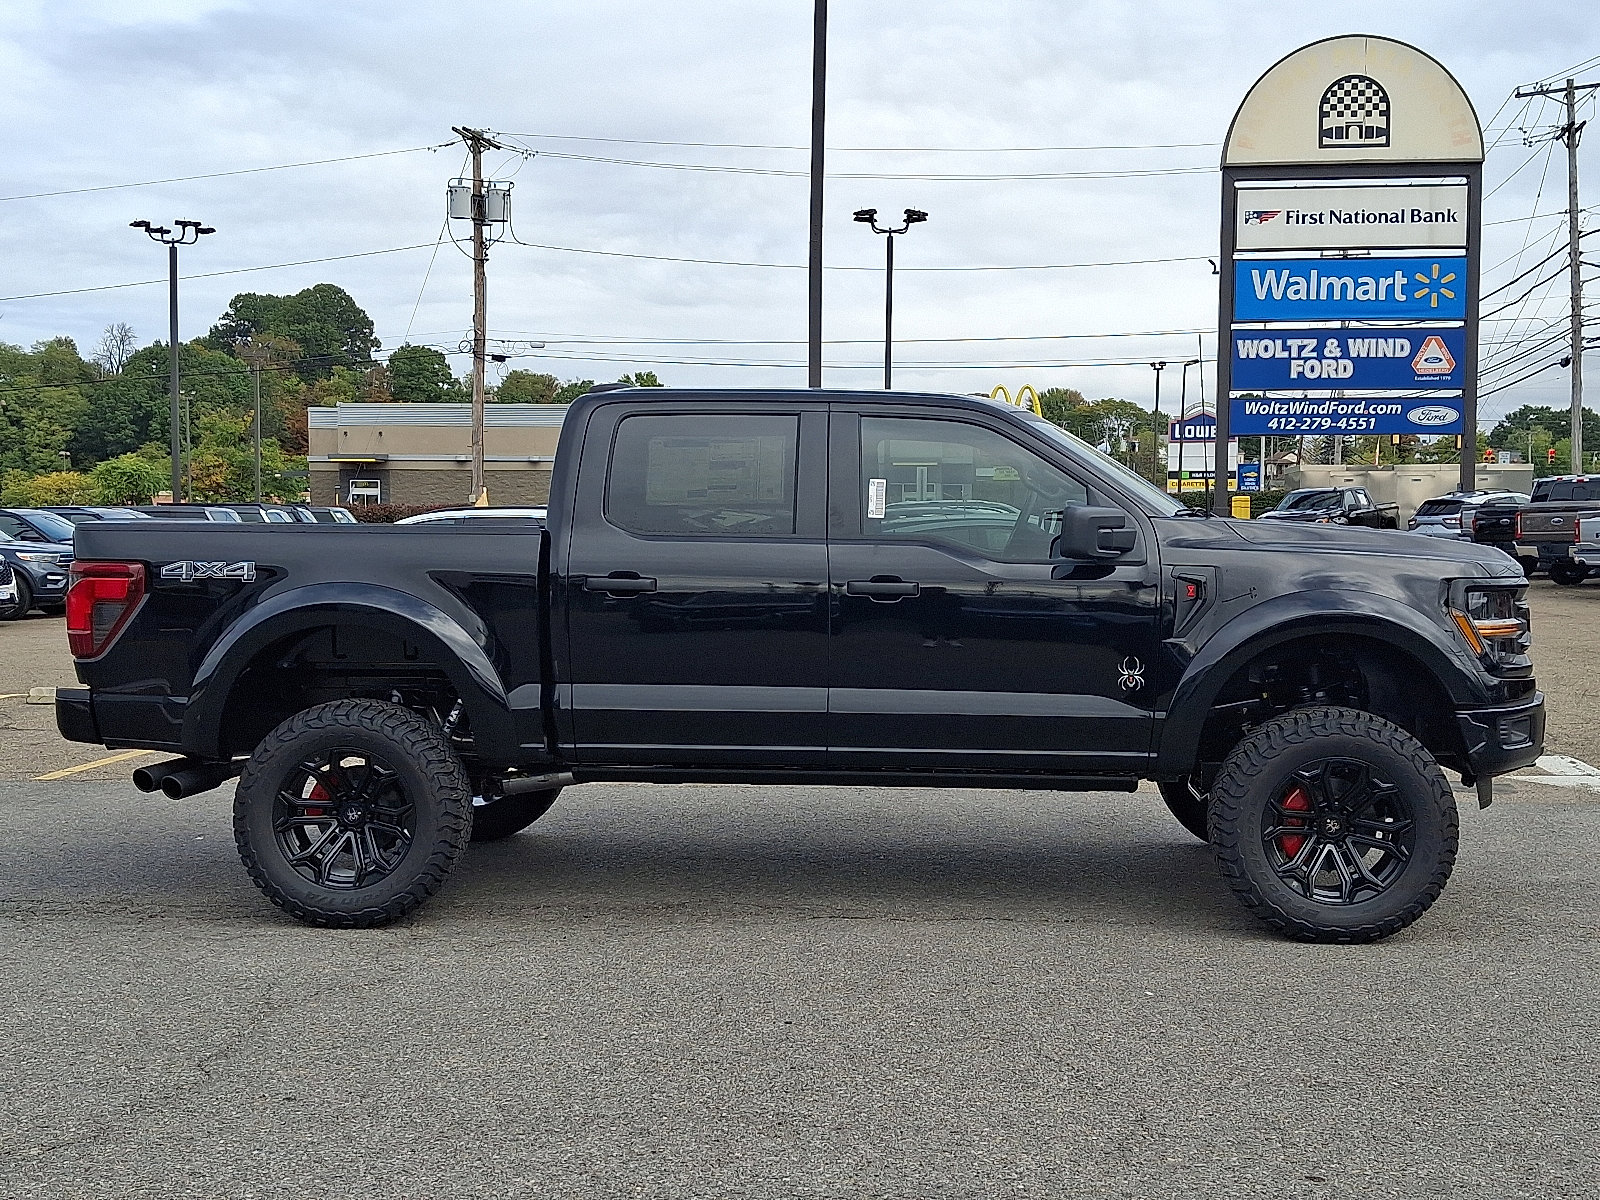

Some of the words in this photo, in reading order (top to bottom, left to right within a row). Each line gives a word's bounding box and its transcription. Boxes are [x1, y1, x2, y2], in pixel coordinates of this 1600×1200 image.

[1285, 209, 1325, 225] First
[1329, 208, 1406, 224] National
[1410, 208, 1458, 223] Bank
[1251, 269, 1408, 301] Walmart
[1236, 338, 1318, 359] WOLTZ
[1323, 338, 1342, 358] &
[1346, 337, 1412, 358] WIND
[1289, 359, 1354, 379] FORD
[1245, 400, 1402, 415] WoltzWindFord.com
[1417, 409, 1449, 421] Ford
[1174, 423, 1217, 438] LOWE
[1267, 417, 1376, 430] 412-279-4551
